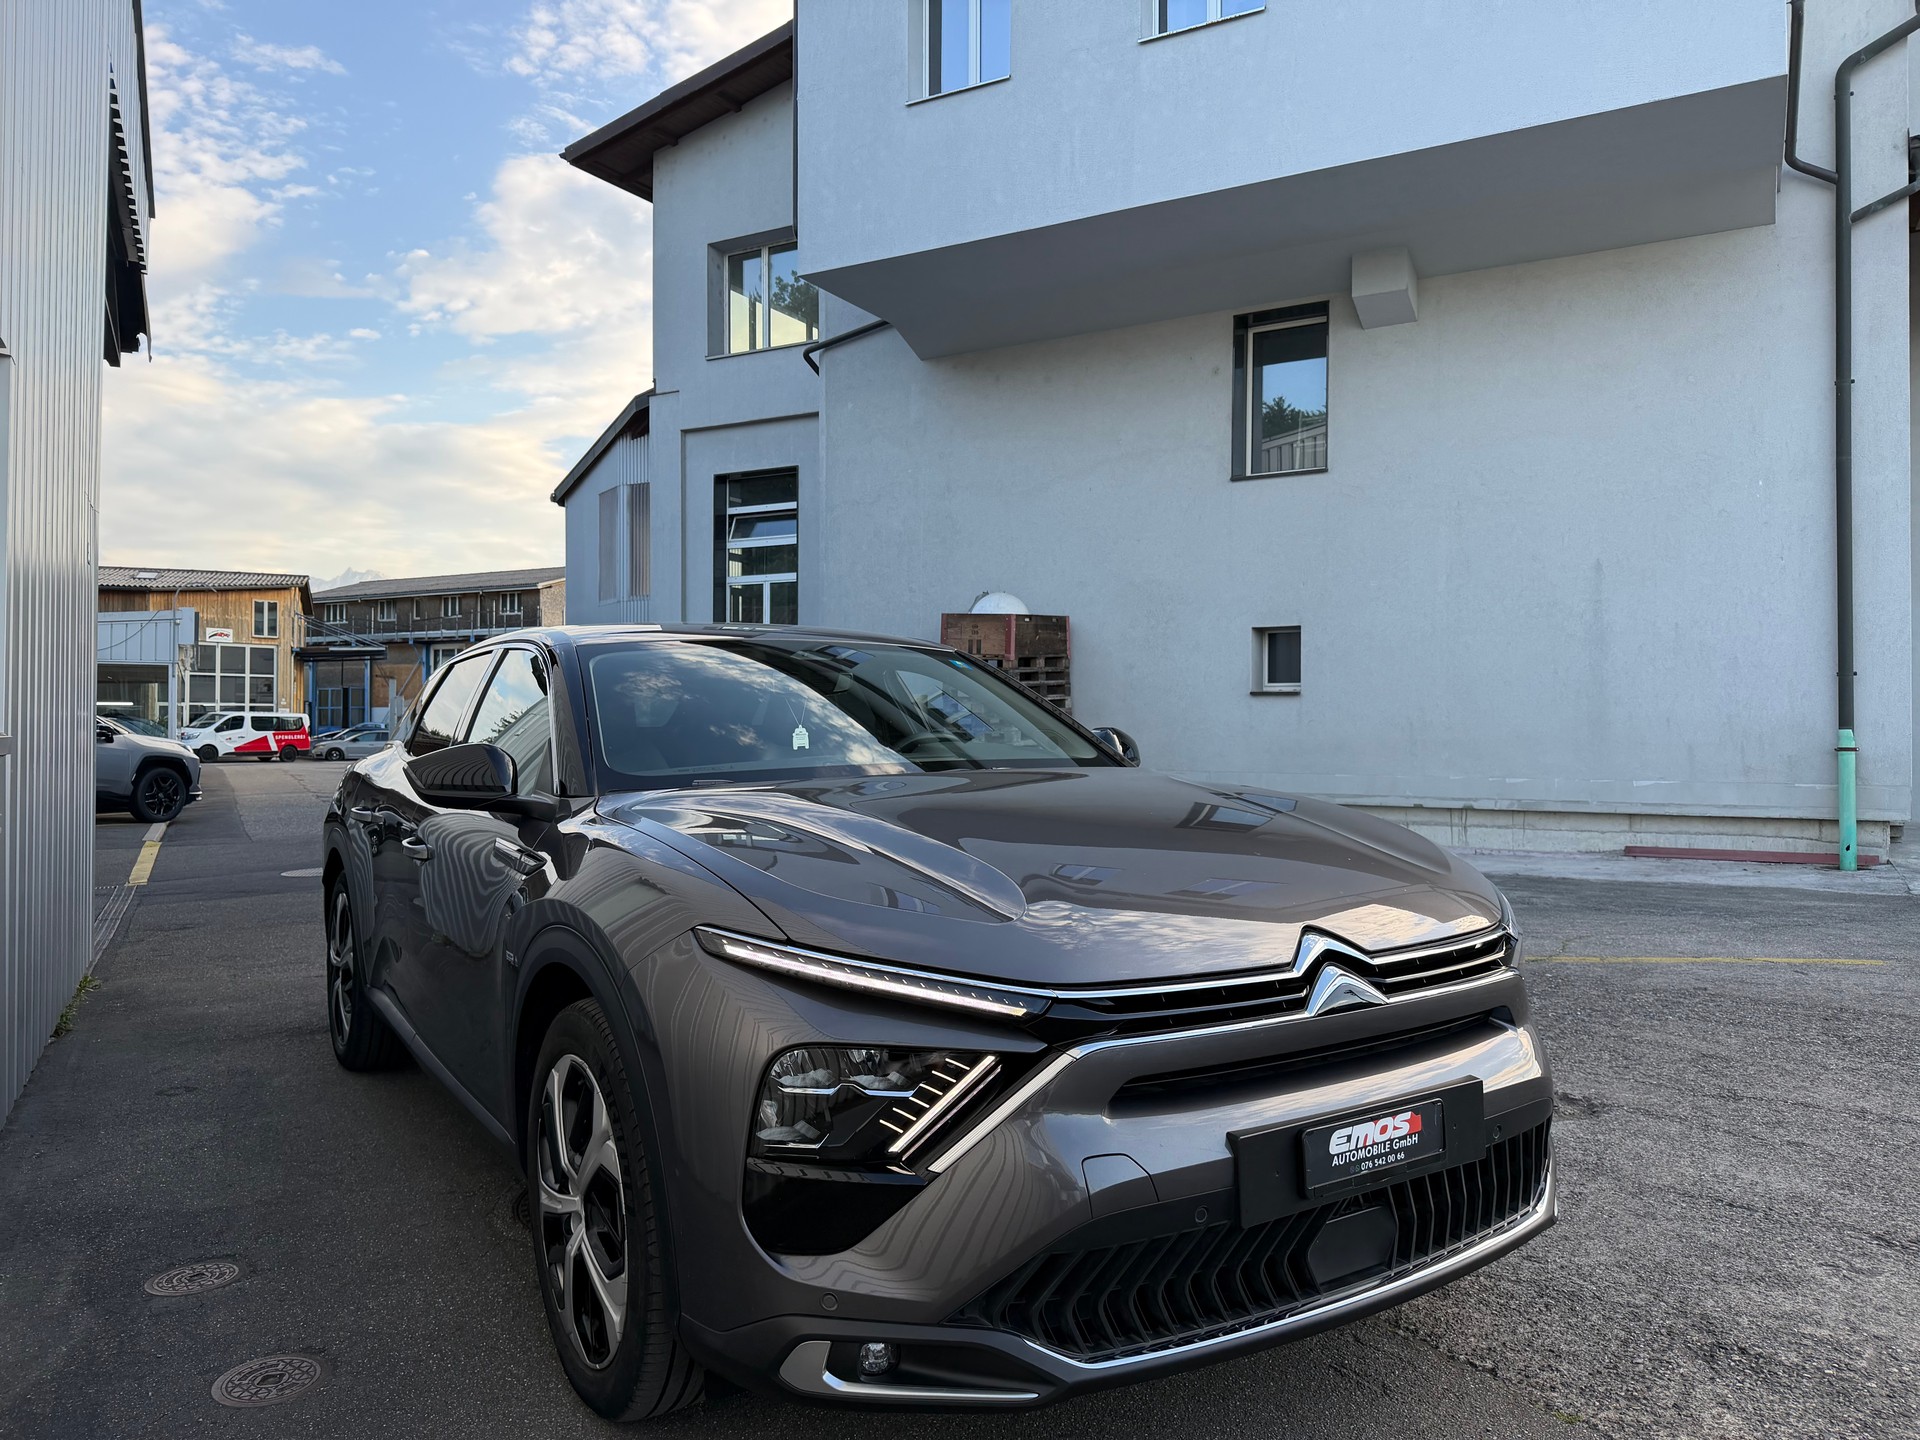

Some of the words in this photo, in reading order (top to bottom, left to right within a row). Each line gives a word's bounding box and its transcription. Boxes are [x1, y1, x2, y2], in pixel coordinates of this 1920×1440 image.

[1332, 1141, 1391, 1167] AUTOMOBILE
[1393, 1133, 1419, 1150] GmbH
[1361, 1161, 1373, 1171] 076
[1374, 1156, 1387, 1167] 542
[1387, 1153, 1396, 1163] 00
[1397, 1151, 1405, 1160] 66
